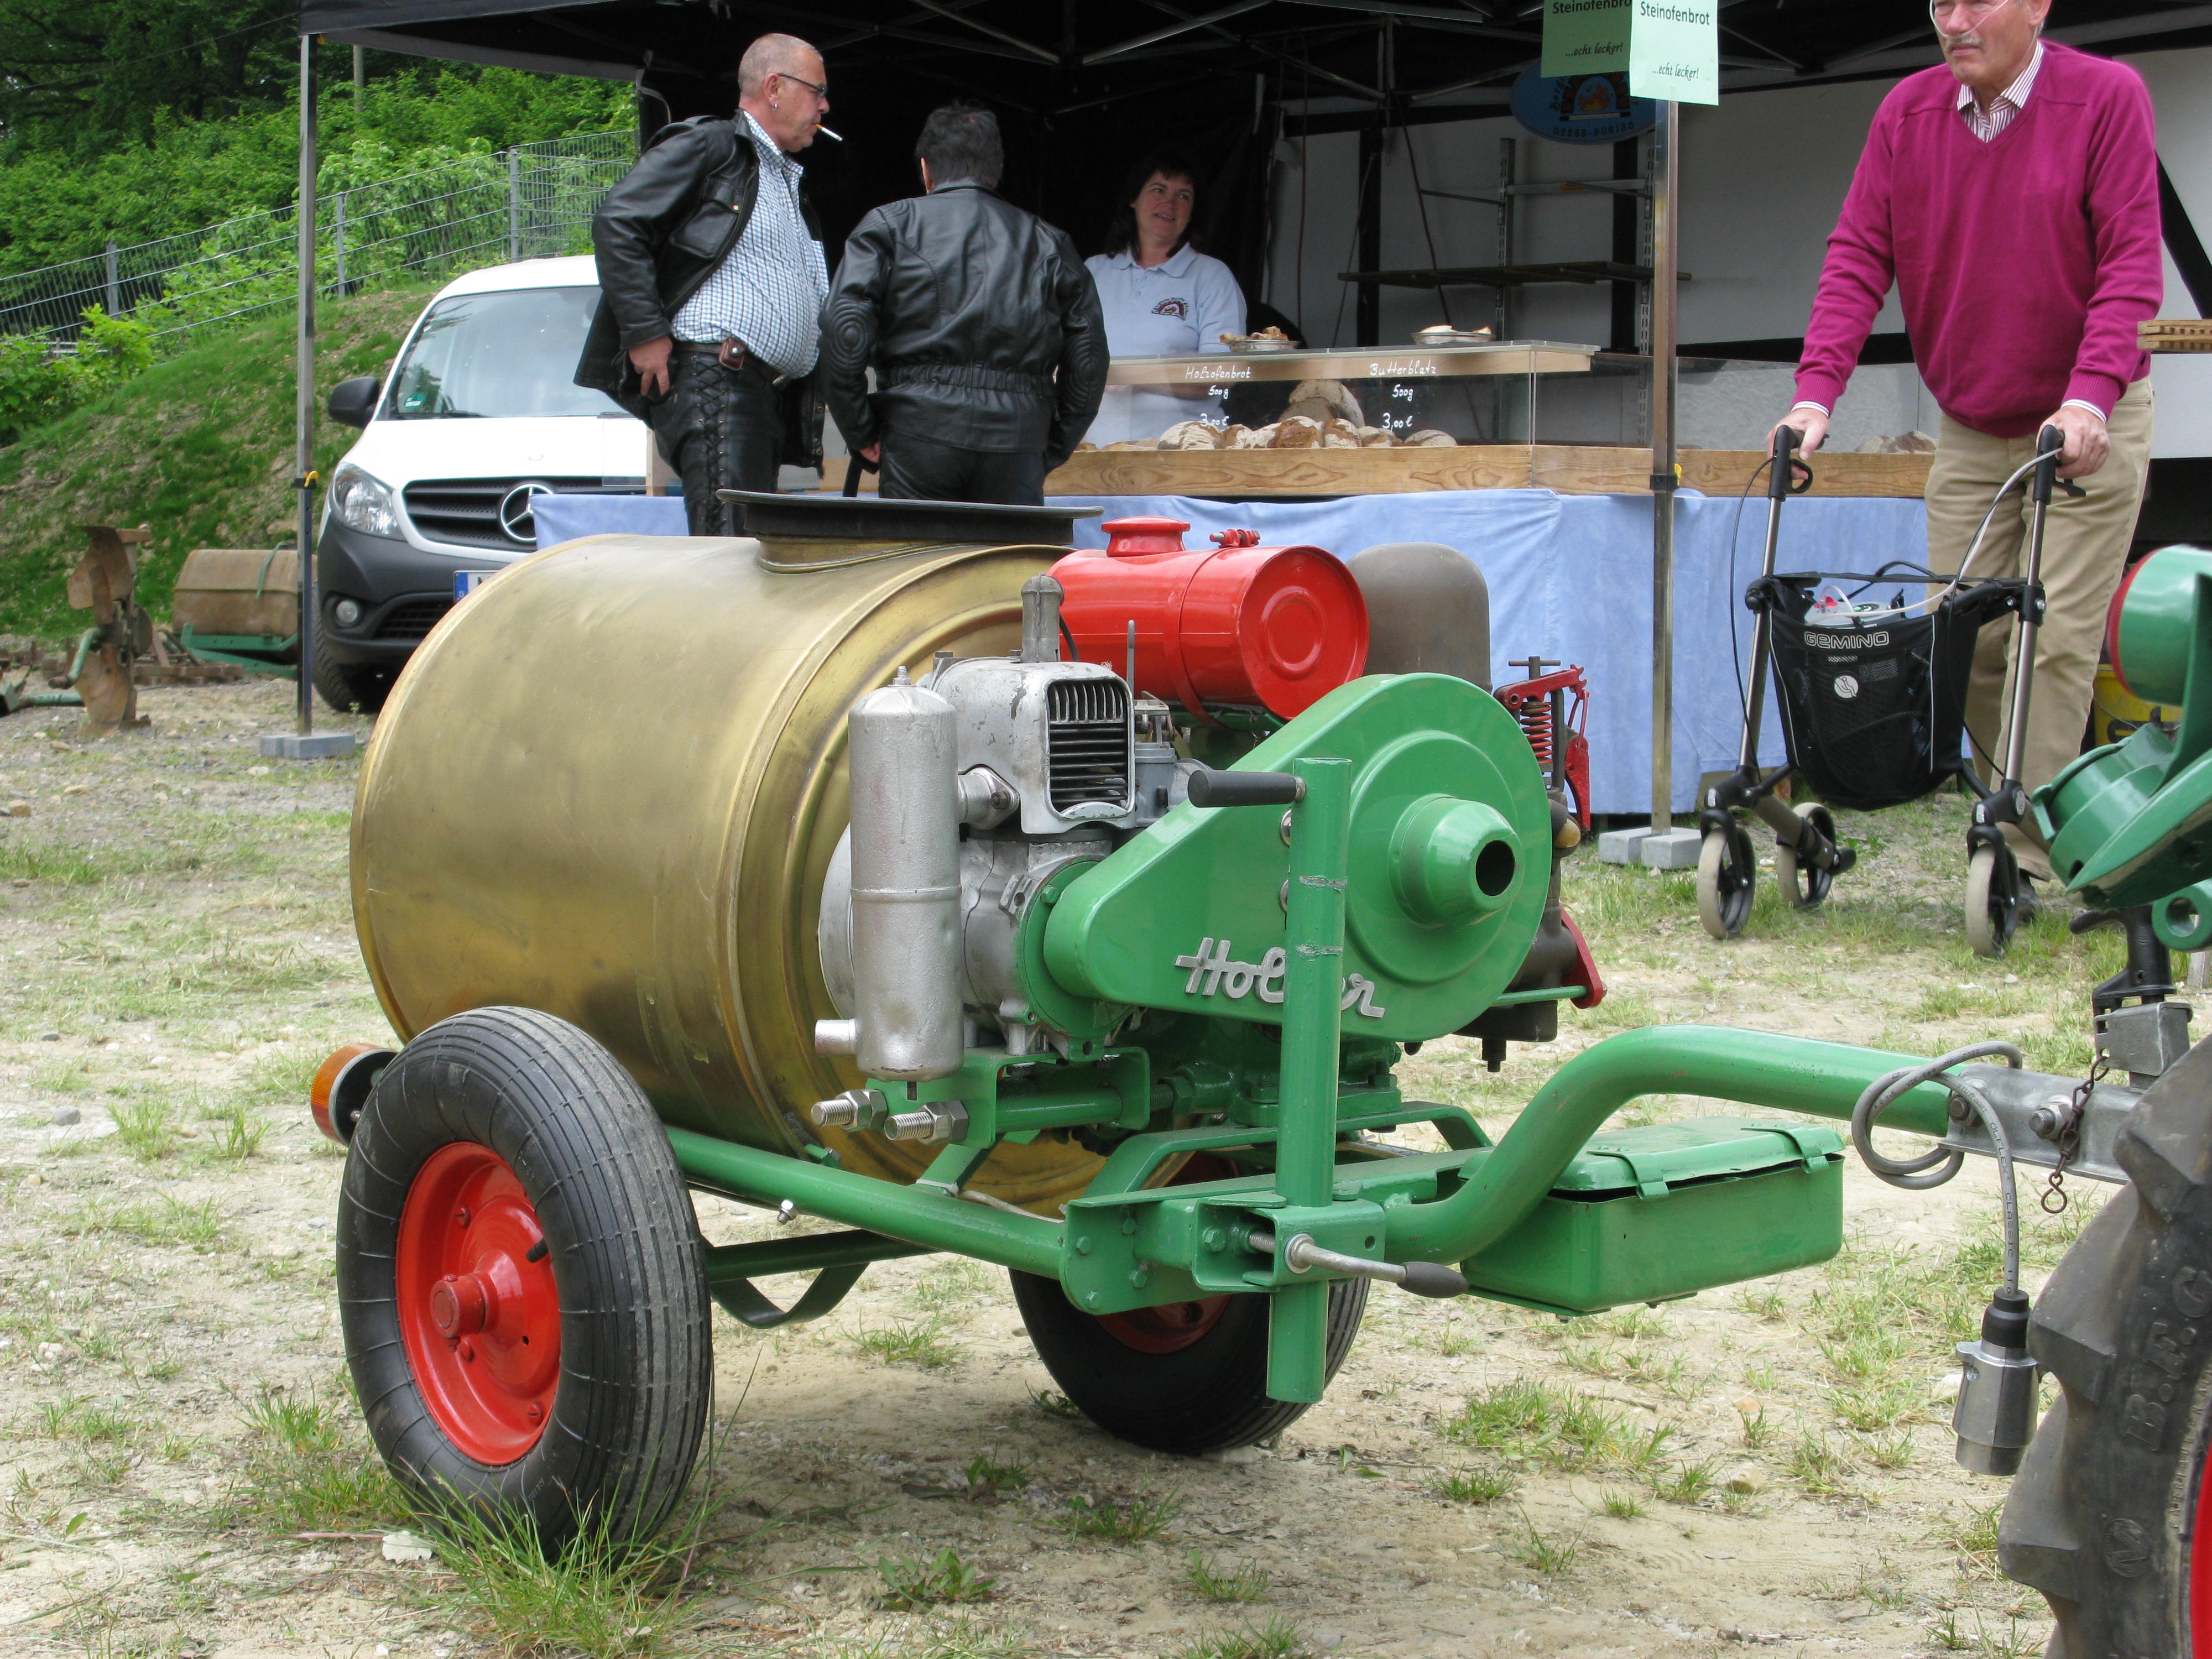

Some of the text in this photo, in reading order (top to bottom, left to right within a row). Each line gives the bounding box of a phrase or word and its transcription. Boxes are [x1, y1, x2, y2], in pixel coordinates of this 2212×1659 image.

[1553, 0, 1631, 14] Steinofenbro
[1640, 1, 1710, 25] Steinofenbrot
[1594, 42, 1623, 55] lecker!
[1674, 64, 1699, 81] lecker!
[1185, 365, 1251, 380] Holzofenbrot
[1370, 359, 1436, 375] Butterblatz
[1175, 937, 1385, 1018] Holr
